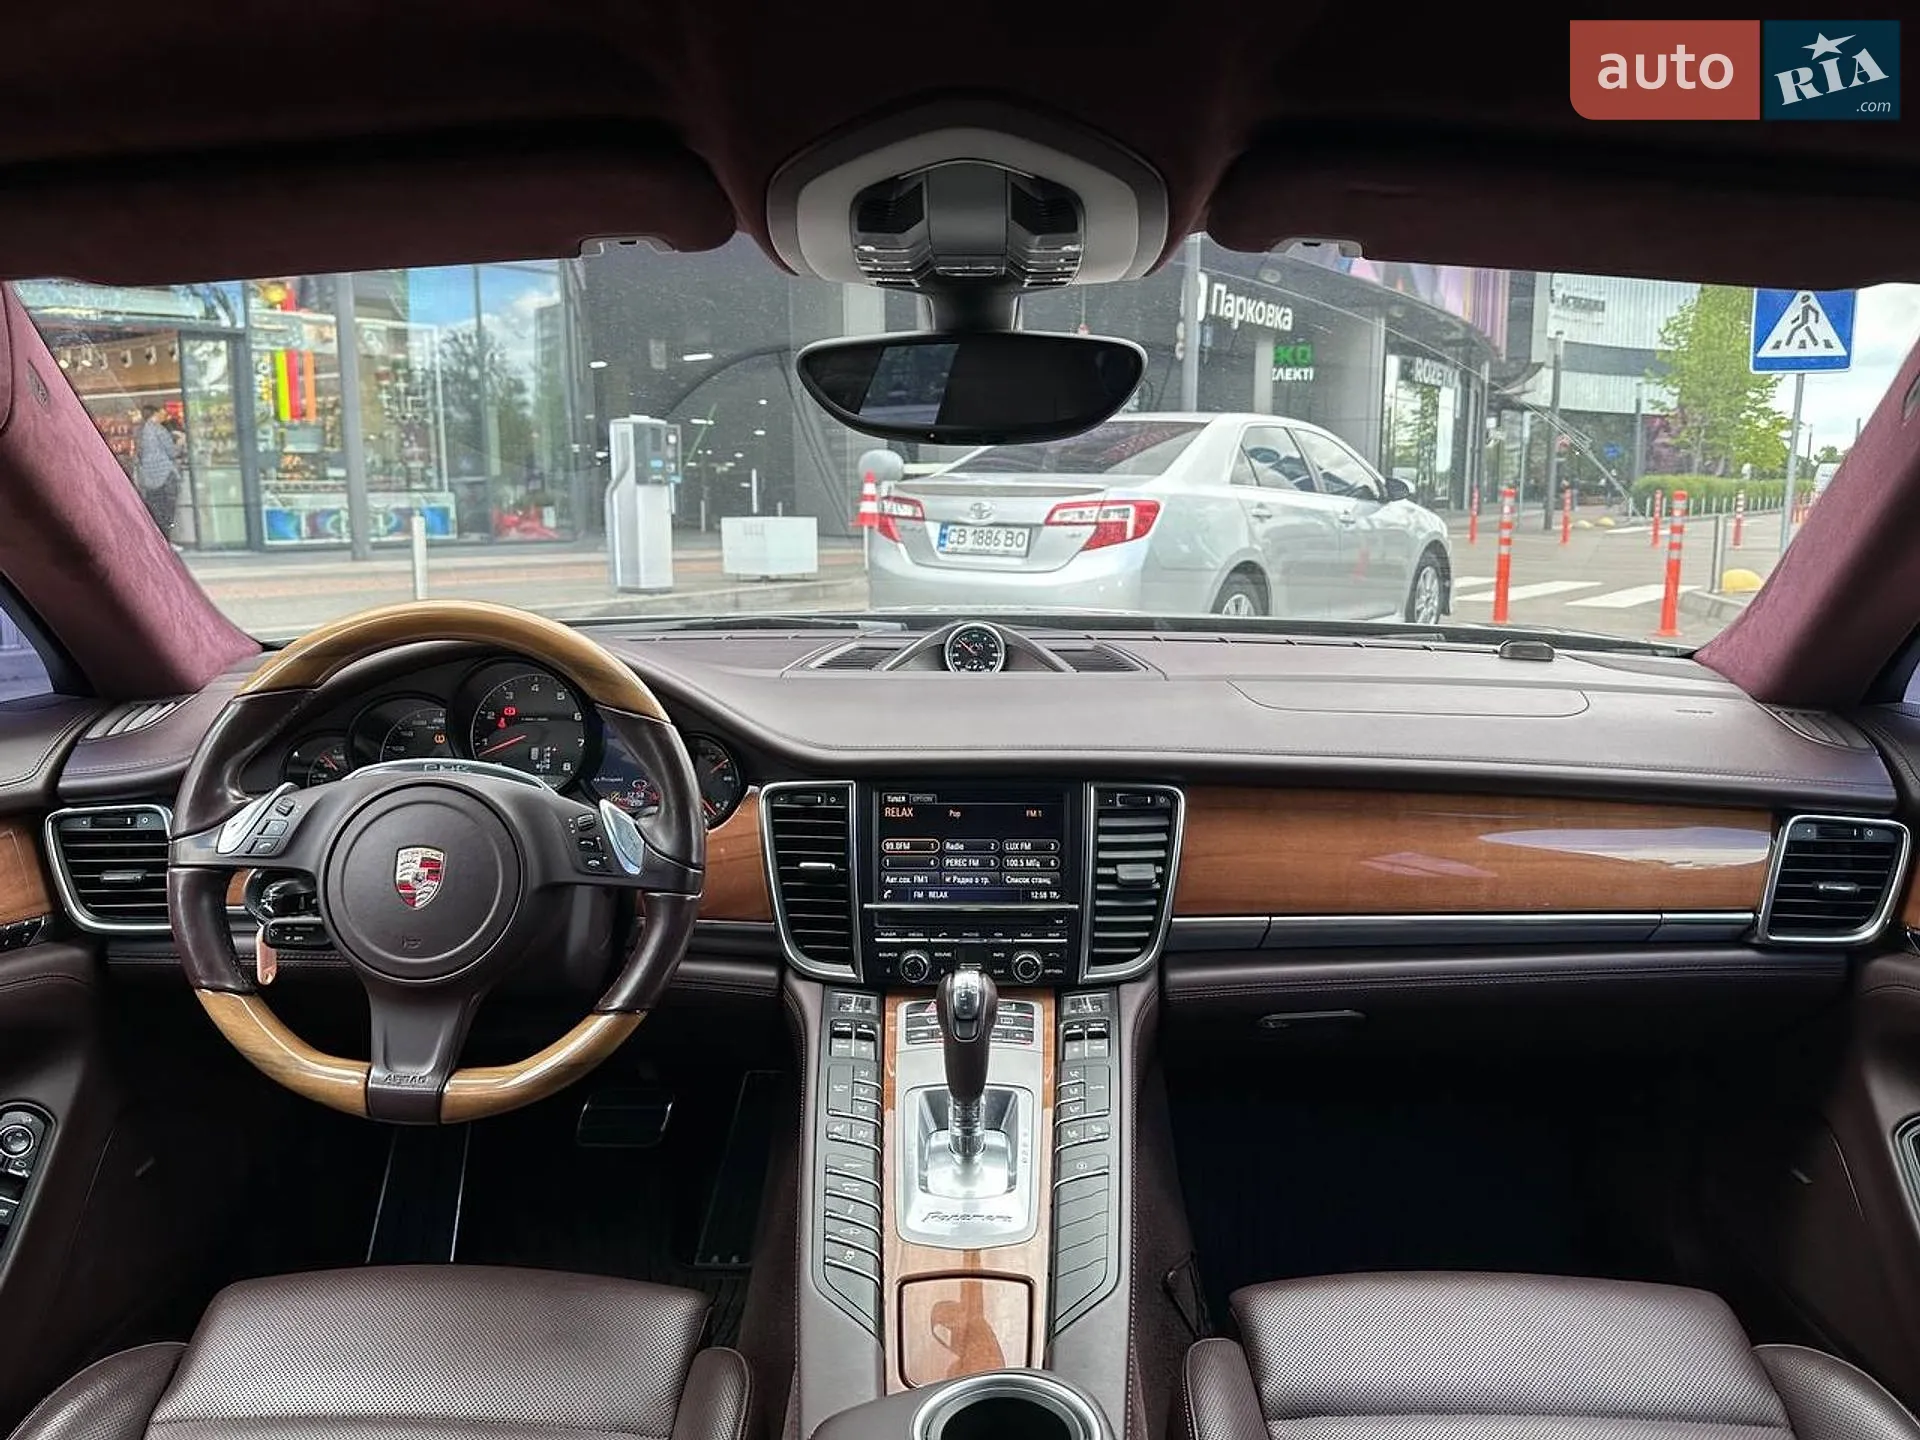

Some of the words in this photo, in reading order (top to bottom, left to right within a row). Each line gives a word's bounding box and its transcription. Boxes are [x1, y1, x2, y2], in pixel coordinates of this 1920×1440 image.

[1211, 282, 1293, 332] Парковка
[947, 528, 968, 545] CB
[971, 530, 1002, 547] 1886
[1003, 531, 1026, 548] BO
[530, 683, 540, 693] 4
[556, 692, 566, 701] 5
[486, 711, 496, 720] 2
[573, 713, 582, 722] 6
[577, 738, 586, 748] 7
[884, 807, 914, 818] RELAX
[948, 809, 962, 820] Pop
[945, 842, 965, 850] Radio
[1005, 842, 1019, 850] LUX
[1020, 842, 1032, 850] FM
[968, 858, 980, 867] FM
[1006, 875, 1030, 885] Список
[921, 1210, 1014, 1224] Panamera
